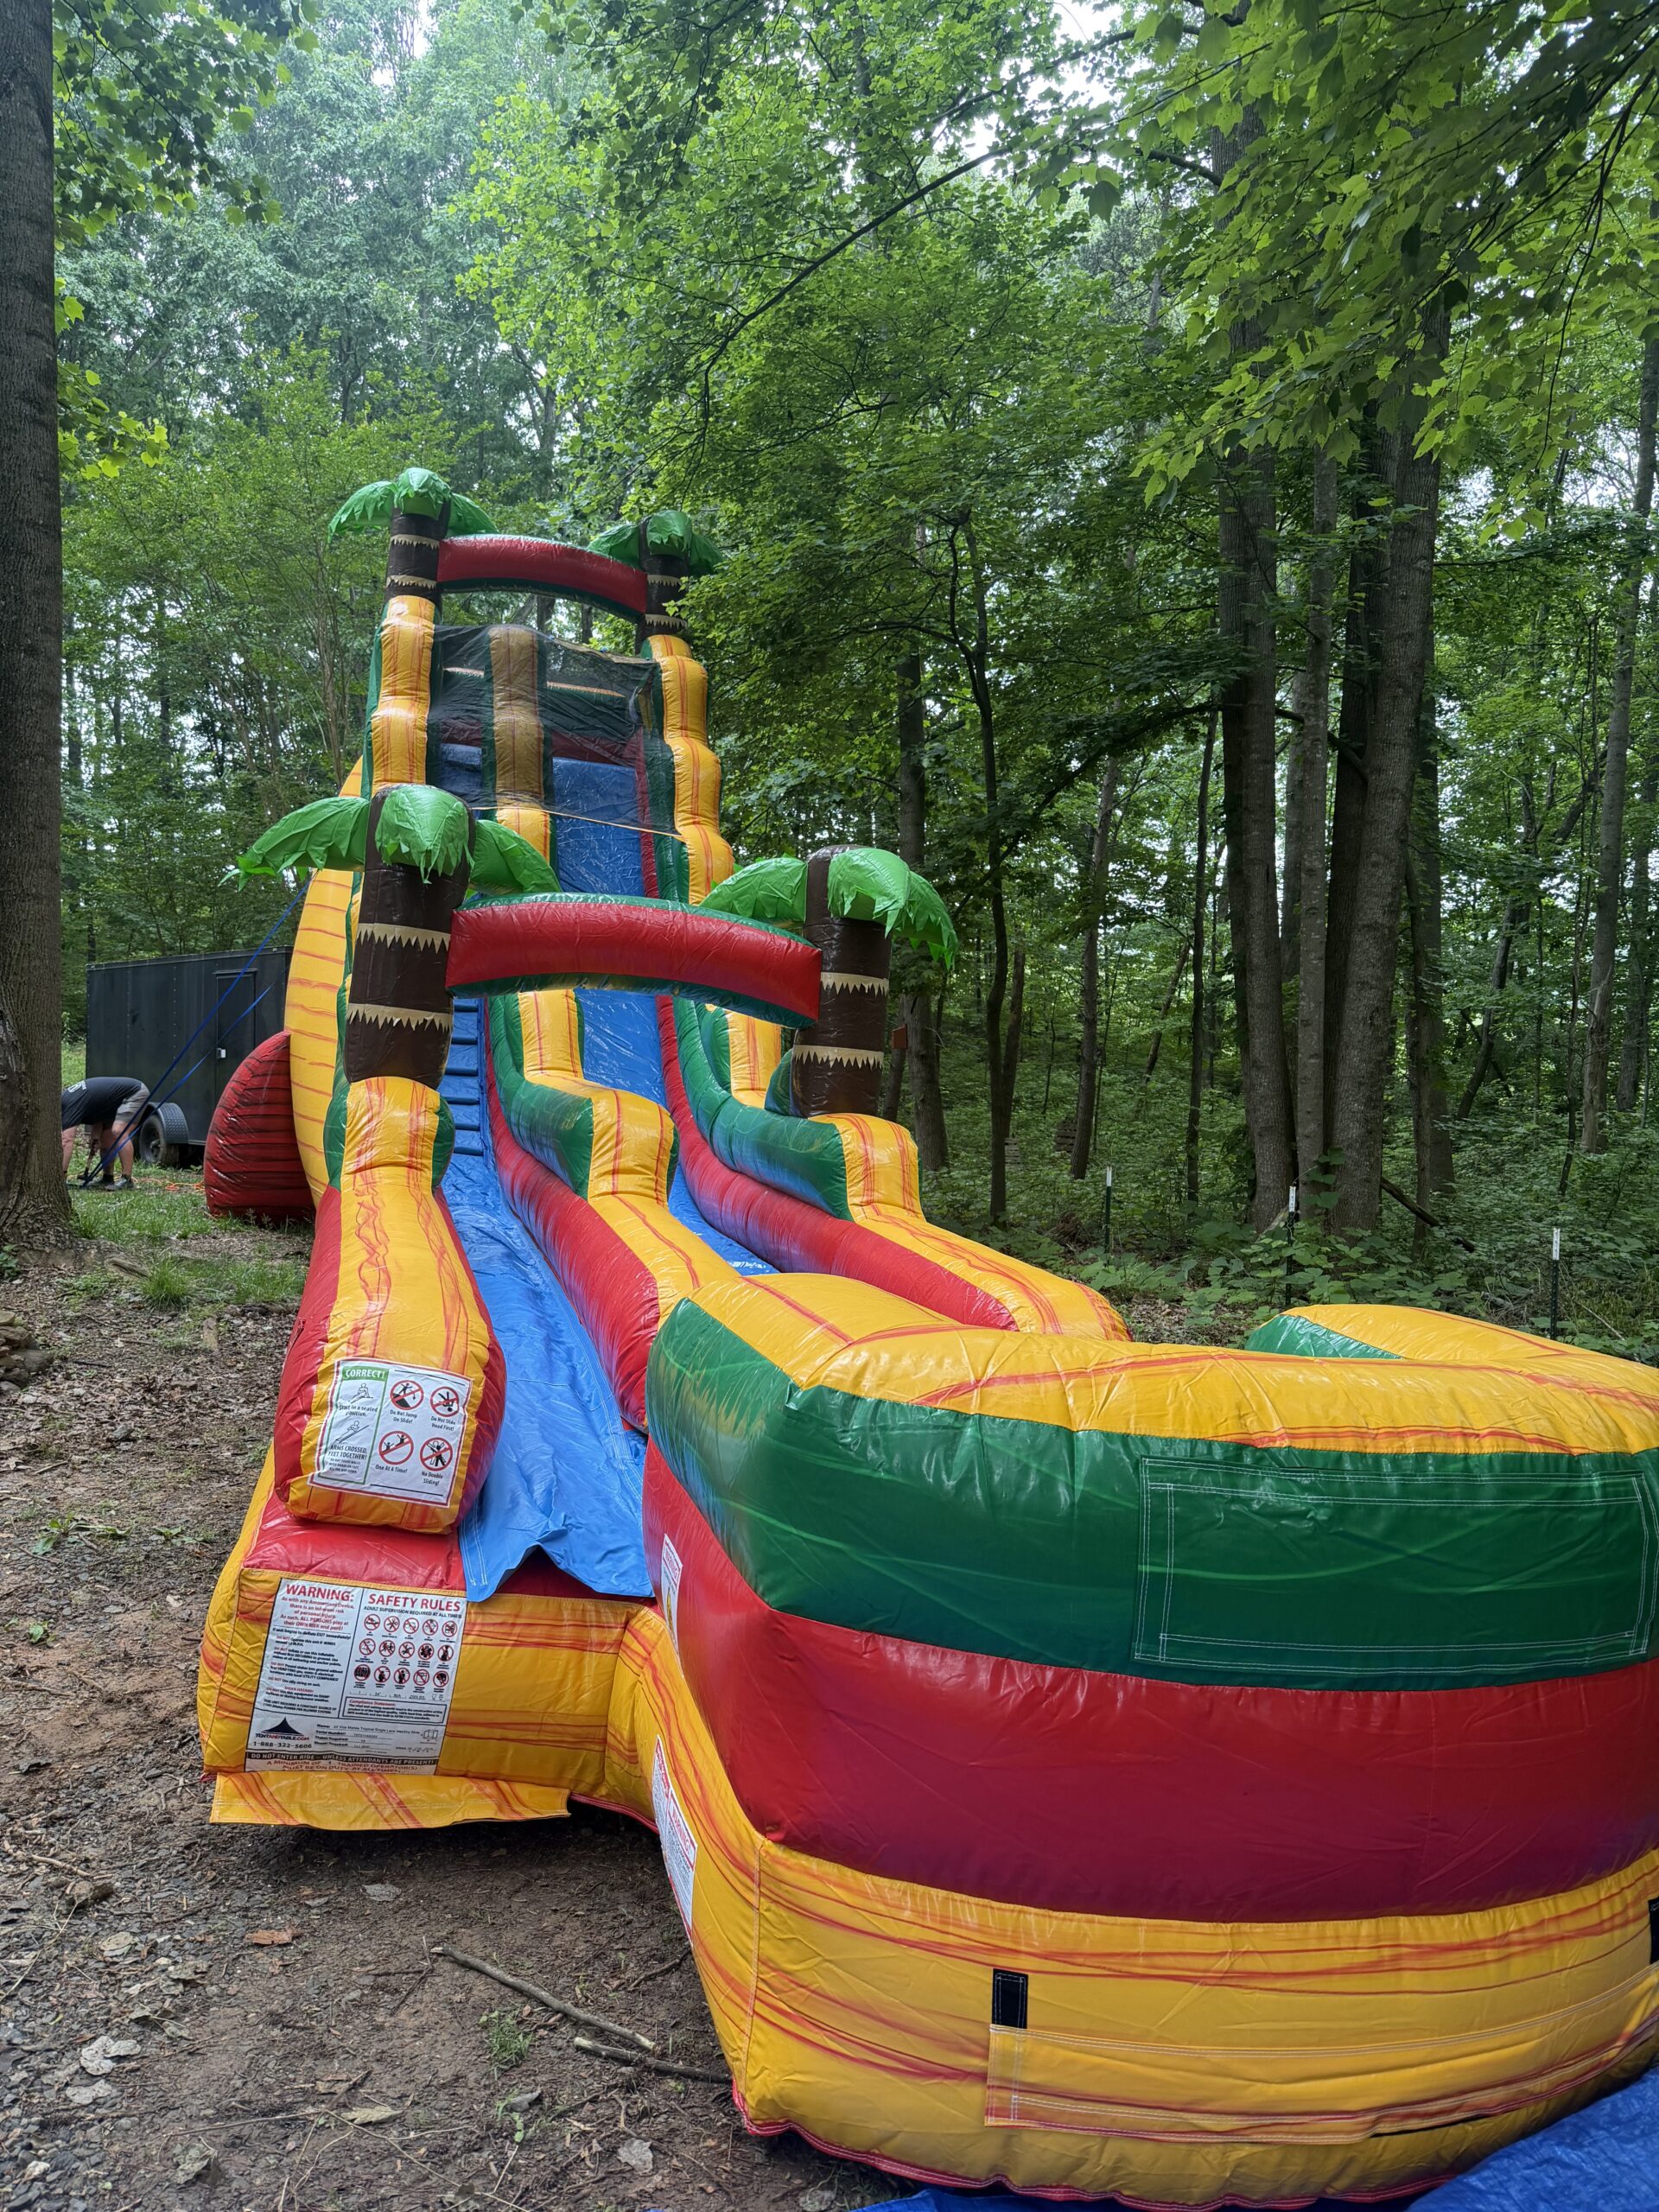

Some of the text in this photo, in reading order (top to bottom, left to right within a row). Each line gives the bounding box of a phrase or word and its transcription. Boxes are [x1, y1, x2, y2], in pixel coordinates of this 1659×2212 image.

[346, 1369, 386, 1379] CORRECT!
[345, 1446, 367, 1454] CROSSED,
[286, 1584, 354, 1602] WARNING:
[368, 1593, 461, 1612] SAFETY RULES
[378, 1606, 410, 1615] SUPERVISION
